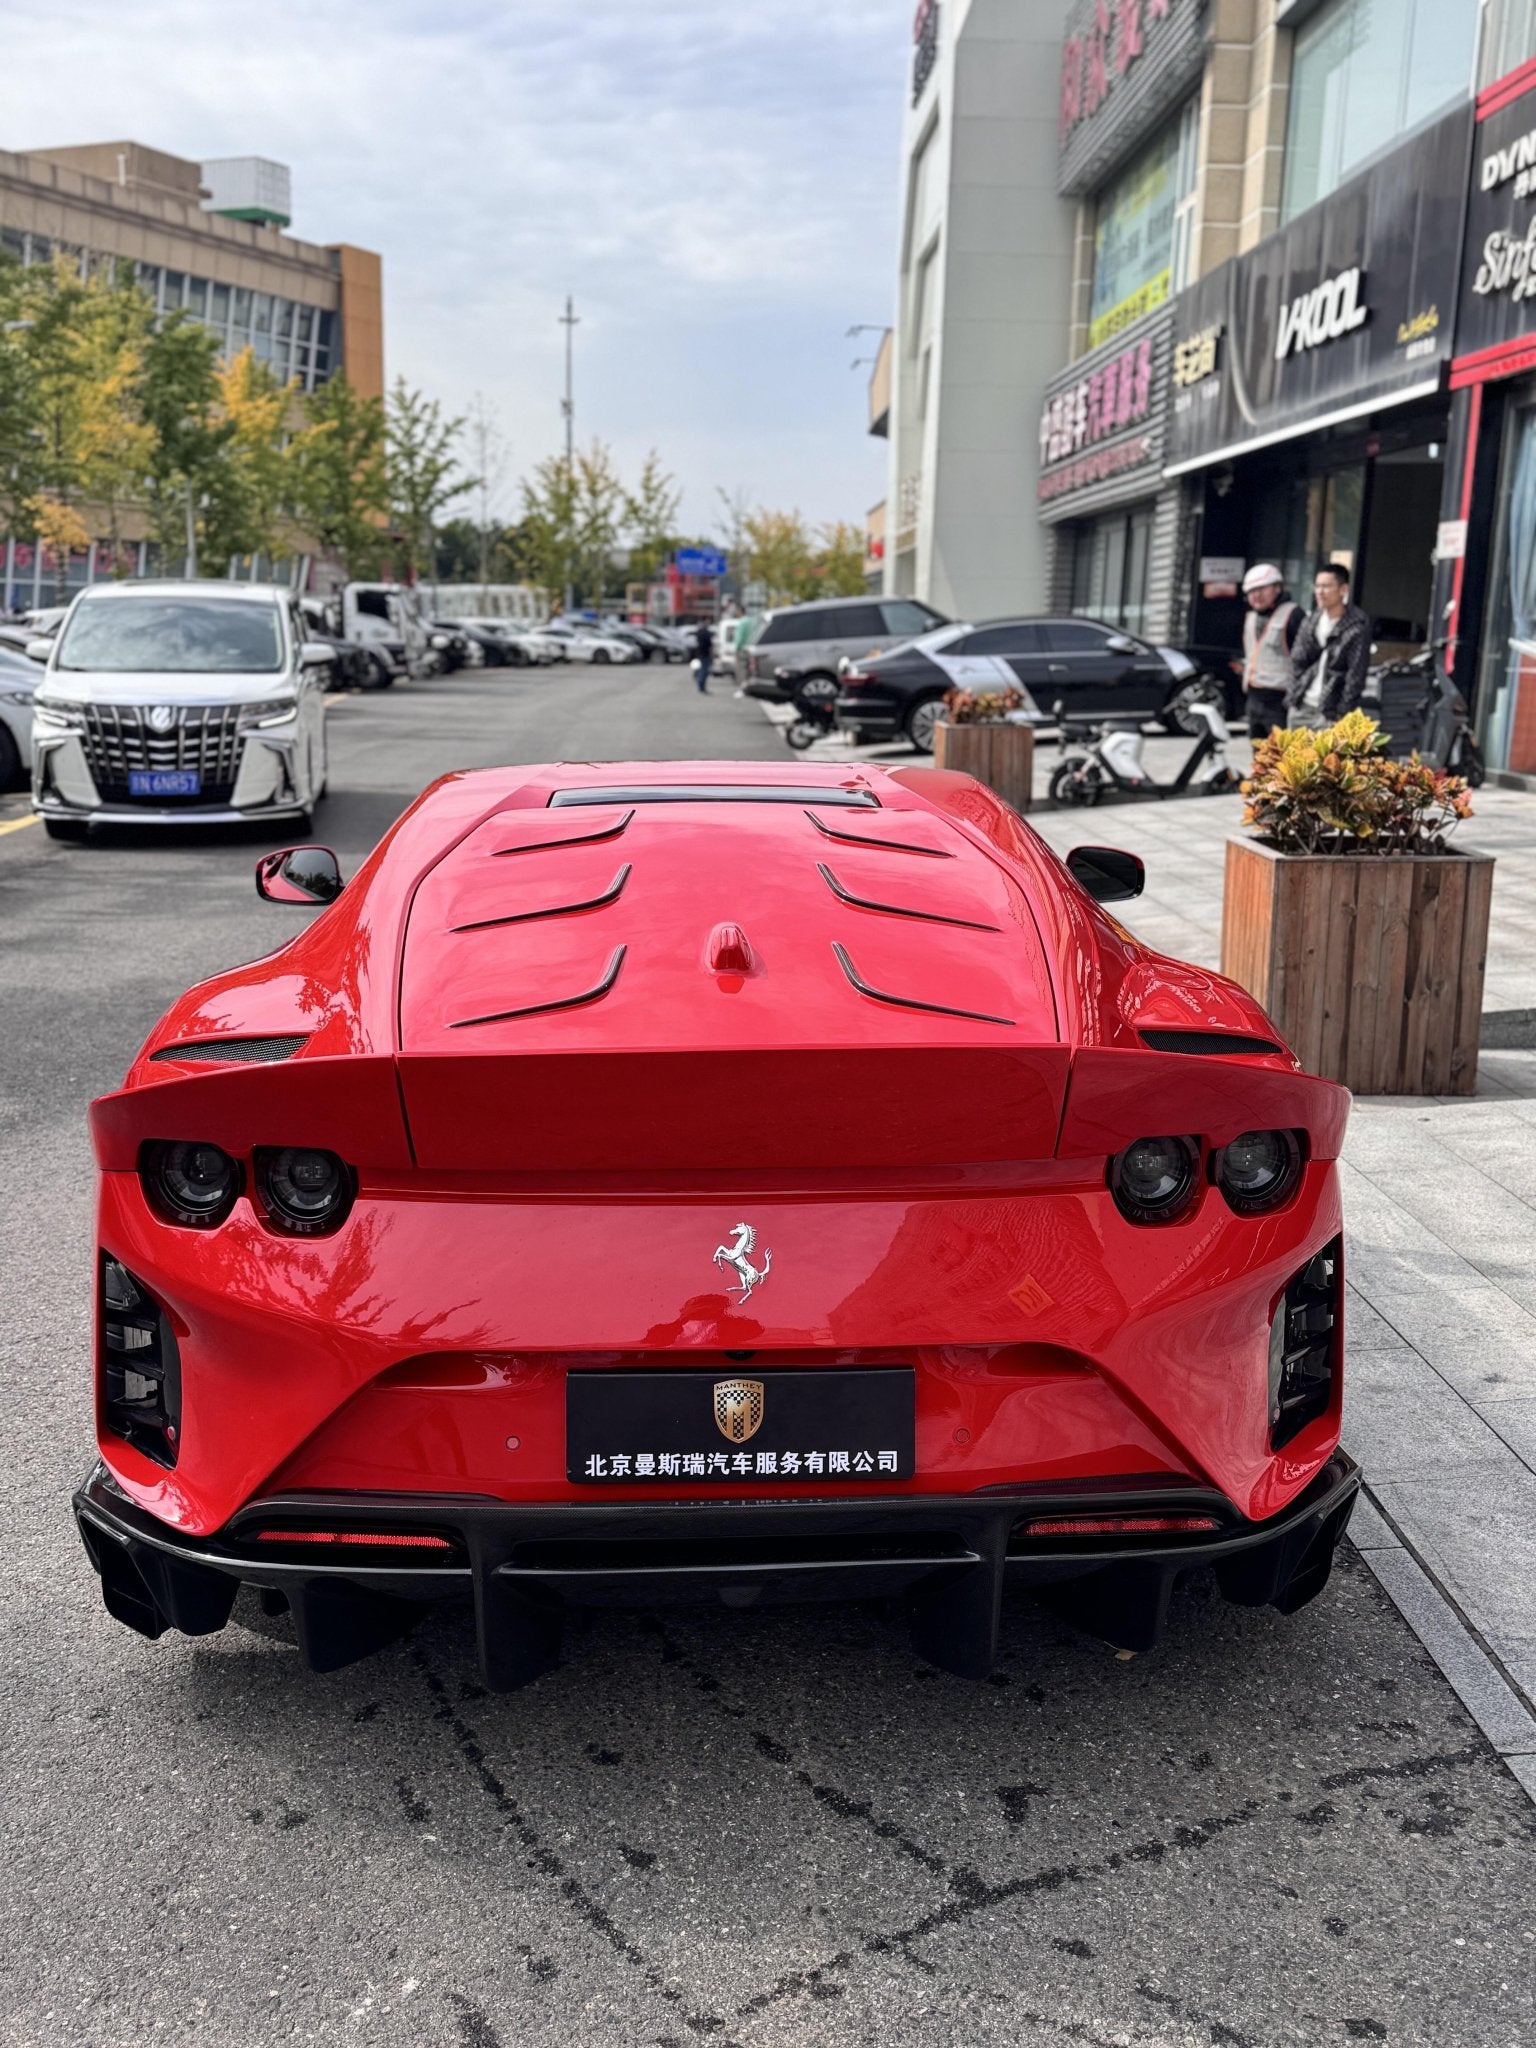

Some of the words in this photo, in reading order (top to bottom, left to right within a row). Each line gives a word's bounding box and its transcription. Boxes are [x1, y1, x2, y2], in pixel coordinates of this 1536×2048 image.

[716, 1381, 762, 1391] MANTHEY
[584, 1450, 898, 1477] 北京曼斯瑞汽车服务有限公司
